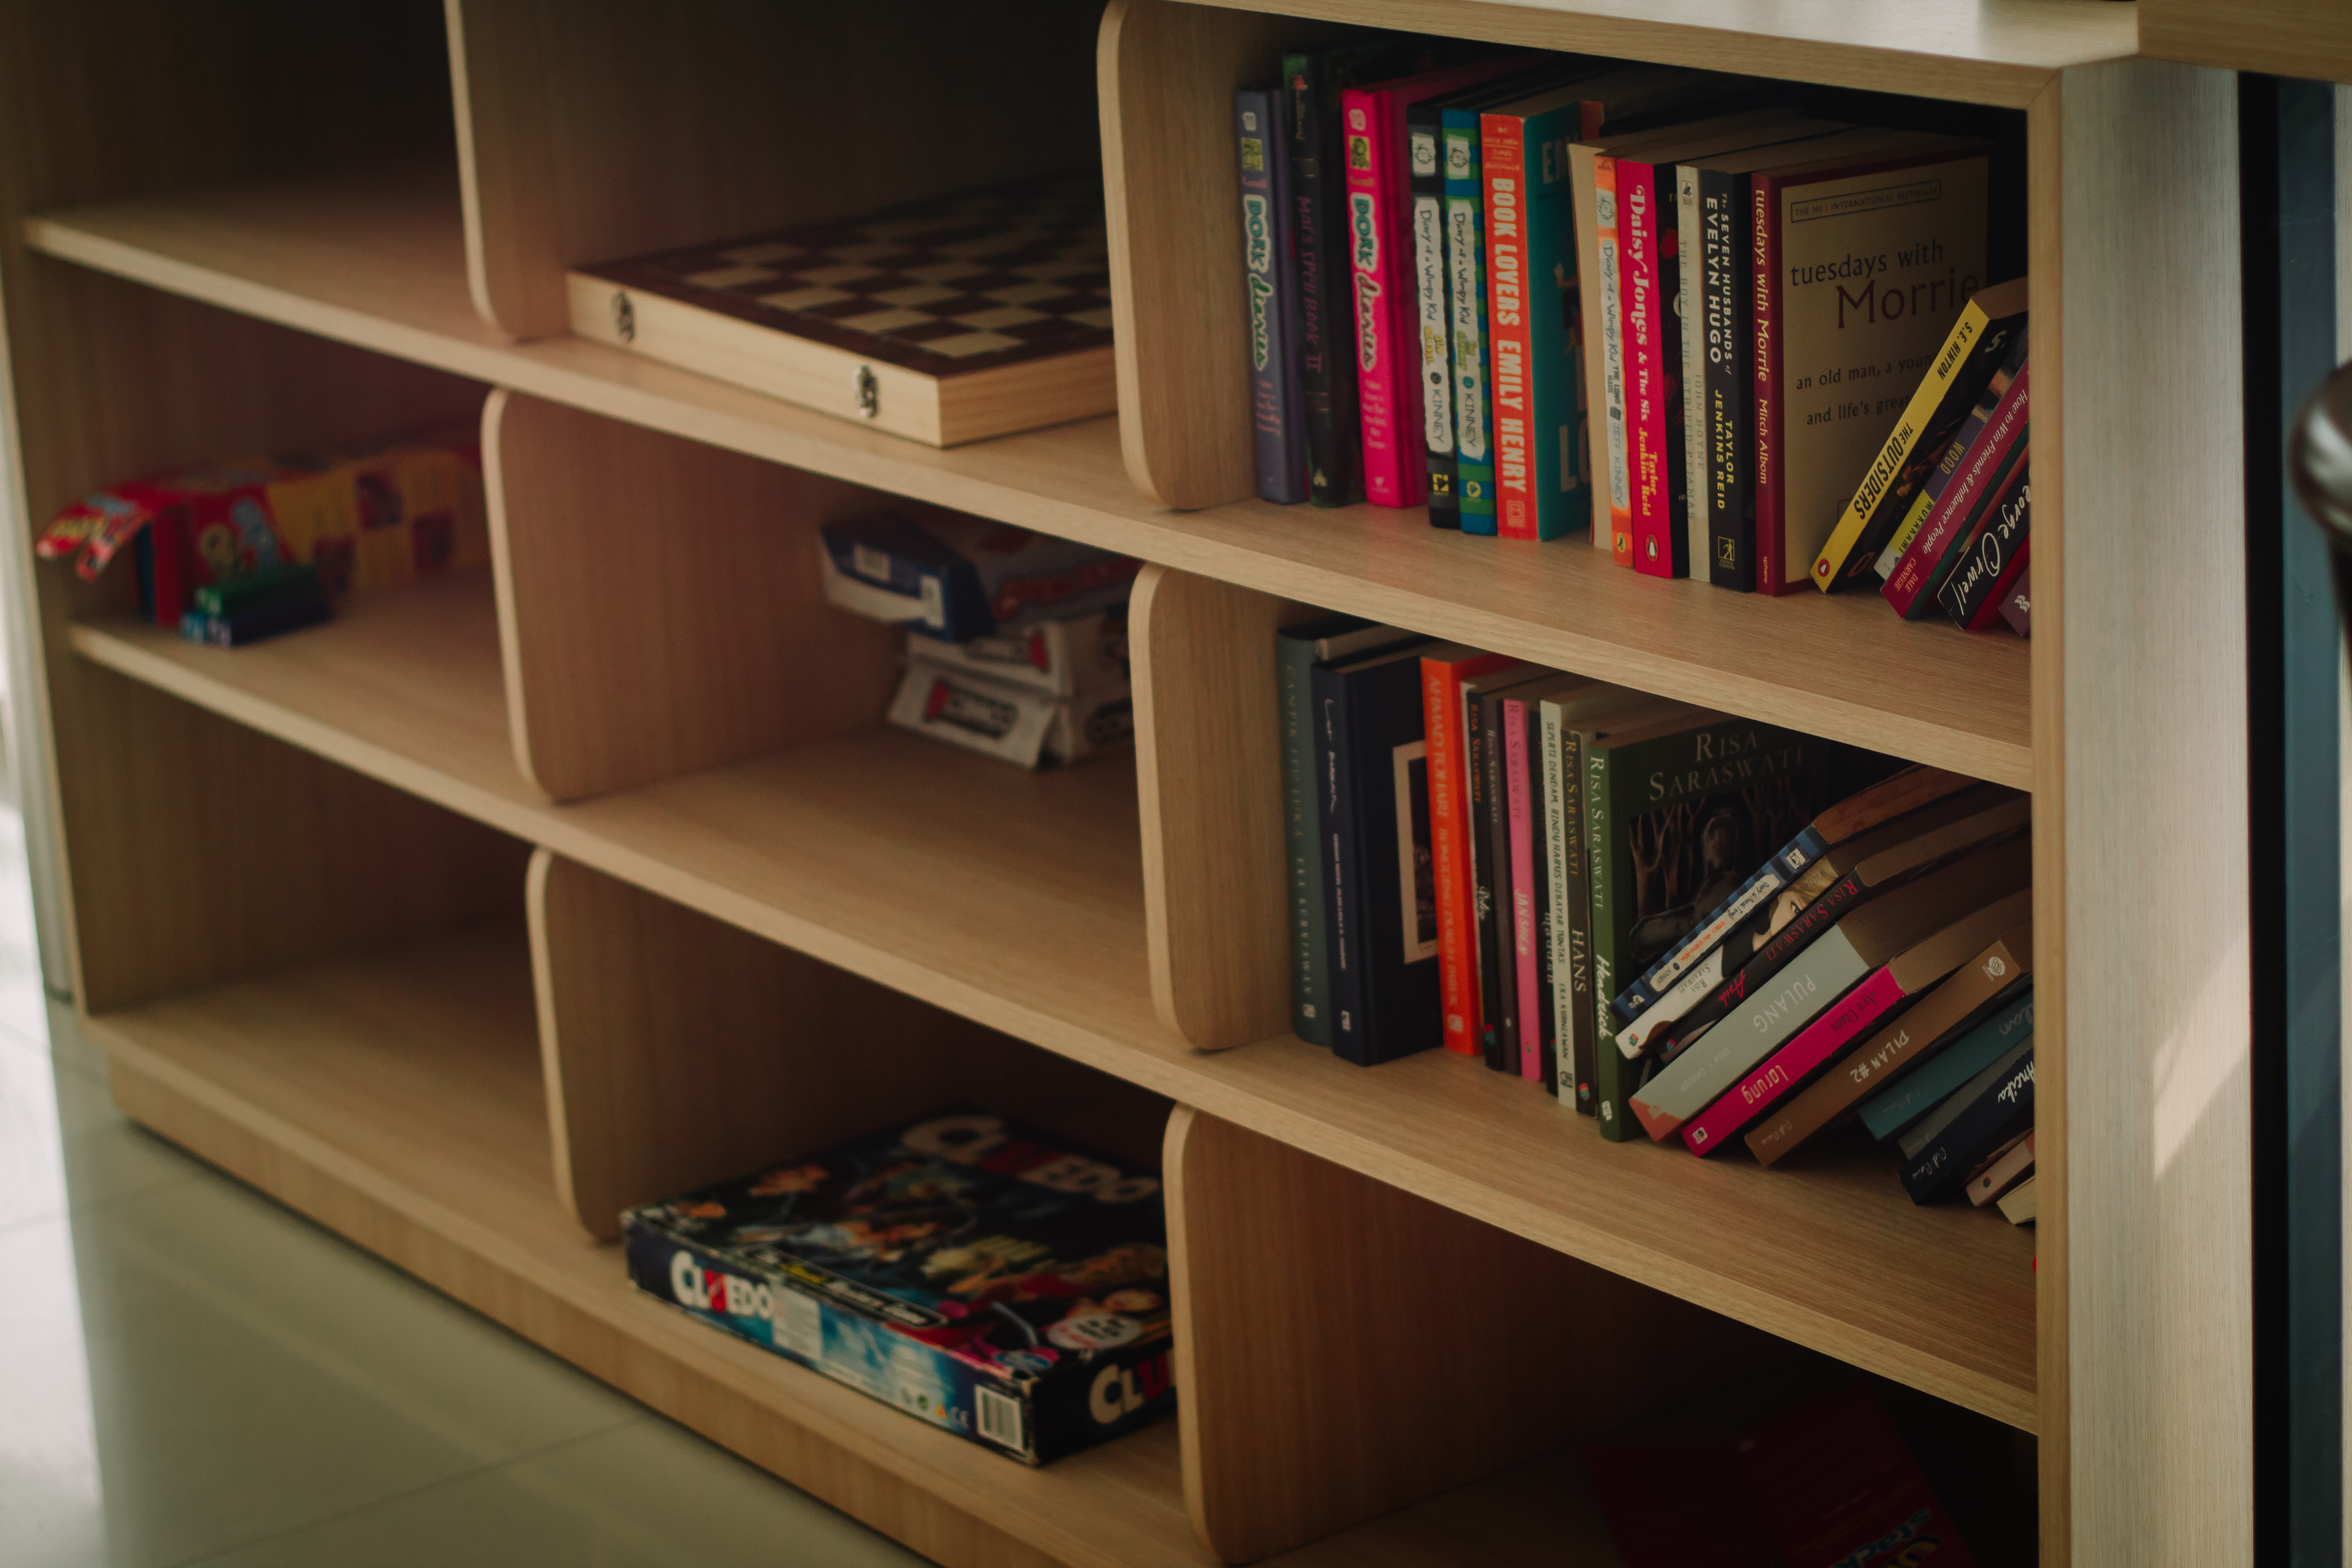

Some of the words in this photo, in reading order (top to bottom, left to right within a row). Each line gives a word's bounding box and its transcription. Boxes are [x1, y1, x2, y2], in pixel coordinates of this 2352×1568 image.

[1492, 178, 1517, 238] BOOK
[1795, 206, 1810, 217] THE
[1831, 194, 1895, 211] INTERNATIONAL
[1897, 186, 1938, 200] BESTSELLER
[1246, 198, 1267, 269] DORK
[1353, 197, 1375, 268] DORK
[1419, 209, 1433, 242] Diary
[1454, 212, 1466, 247] Diary
[1627, 184, 1649, 274] Daisy
[1706, 196, 1720, 287] EVELYN
[1721, 213, 1730, 267] SEVEN
[1754, 189, 1769, 267] tuesdays
[1603, 246, 1614, 281] Diary
[1679, 240, 1688, 269] THE
[1791, 254, 1888, 287] tuesdays
[1898, 238, 1944, 268] with
[1420, 264, 1434, 300] Wimpy
[1455, 267, 1468, 309] Wimpy
[1495, 243, 1521, 327] LOVERS
[1756, 273, 1770, 312] with
[1836, 267, 1979, 329] Morrie
[1249, 275, 1272, 368] diaries
[1356, 274, 1379, 368] diaries
[1425, 303, 1438, 321] Kid
[1459, 307, 1471, 325] Kid
[1606, 303, 1615, 341] Wimpy
[1630, 270, 1650, 346] Jones
[1682, 316, 1689, 332] IN
[1722, 273, 1733, 361] HUSBANDS
[1709, 294, 1722, 364] HUGO
[1608, 342, 1617, 363] Kid
[1637, 350, 1647, 365] &
[1682, 339, 1691, 368] THE
[1757, 318, 1770, 382] Morrie
[1936, 341, 1961, 381] HINTON
[1497, 340, 1524, 411] EMILY
[1639, 367, 1650, 398] The
[1726, 365, 1732, 376] of
[1797, 377, 1813, 390] an
[1819, 367, 1842, 387] old
[1849, 365, 1881, 382] man,
[1885, 362, 1893, 373] a
[1899, 353, 1936, 371] youn
[1639, 398, 1651, 423] Six
[1684, 377, 1693, 442] STRIPED
[1695, 373, 1704, 411] JOHN
[2011, 389, 2028, 414] How
[1432, 389, 1444, 443] KINNEY
[1465, 393, 1477, 448] KINNEY
[1715, 389, 1725, 463] JENKINS
[1758, 398, 1769, 436] Mitch
[1806, 408, 1832, 426] and
[1838, 400, 1870, 421] life's
[1993, 423, 2008, 443] Win
[2005, 412, 2013, 423] to
[1612, 422, 1622, 452] JEFF
[1696, 419, 1704, 470] BOYNE
[1725, 420, 1735, 485] TAYLOR
[1901, 422, 1914, 445] THE
[1501, 417, 1528, 493] HENRY
[1638, 426, 1649, 482] Jenkins
[1647, 451, 1659, 497] Taylor
[1759, 439, 1768, 485] Albom
[1940, 441, 1965, 475] WOOD
[1972, 439, 1996, 476] Friends
[1612, 456, 1624, 504] KINNEY
[1716, 470, 1726, 510] REID
[1853, 436, 1905, 520] OUTSIDERS
[1966, 474, 1974, 486] &
[1641, 484, 1652, 517] Reid
[1941, 482, 1969, 521] Influence
[1998, 485, 2031, 539] eorge
[1922, 524, 1944, 555] People
[1893, 557, 1916, 592] CARNEGIE
[1904, 573, 1918, 593] DALE
[1951, 532, 2000, 617] Orwell
[1572, 929, 1586, 993] HANS
[1595, 954, 1613, 1040] Hendrick
[1718, 967, 1746, 1007] Asih
[1753, 973, 1817, 1033] PULANG
[1857, 991, 1876, 1011] Ayu
[1831, 1009, 1859, 1036] Utami
[1870, 1030, 1909, 1069] DILAN
[1740, 1064, 1790, 1105] Larung
[1849, 1062, 1870, 1083] #2
[1998, 1061, 2035, 1104] Ancika
[1088, 1348, 1176, 1425] CLU
